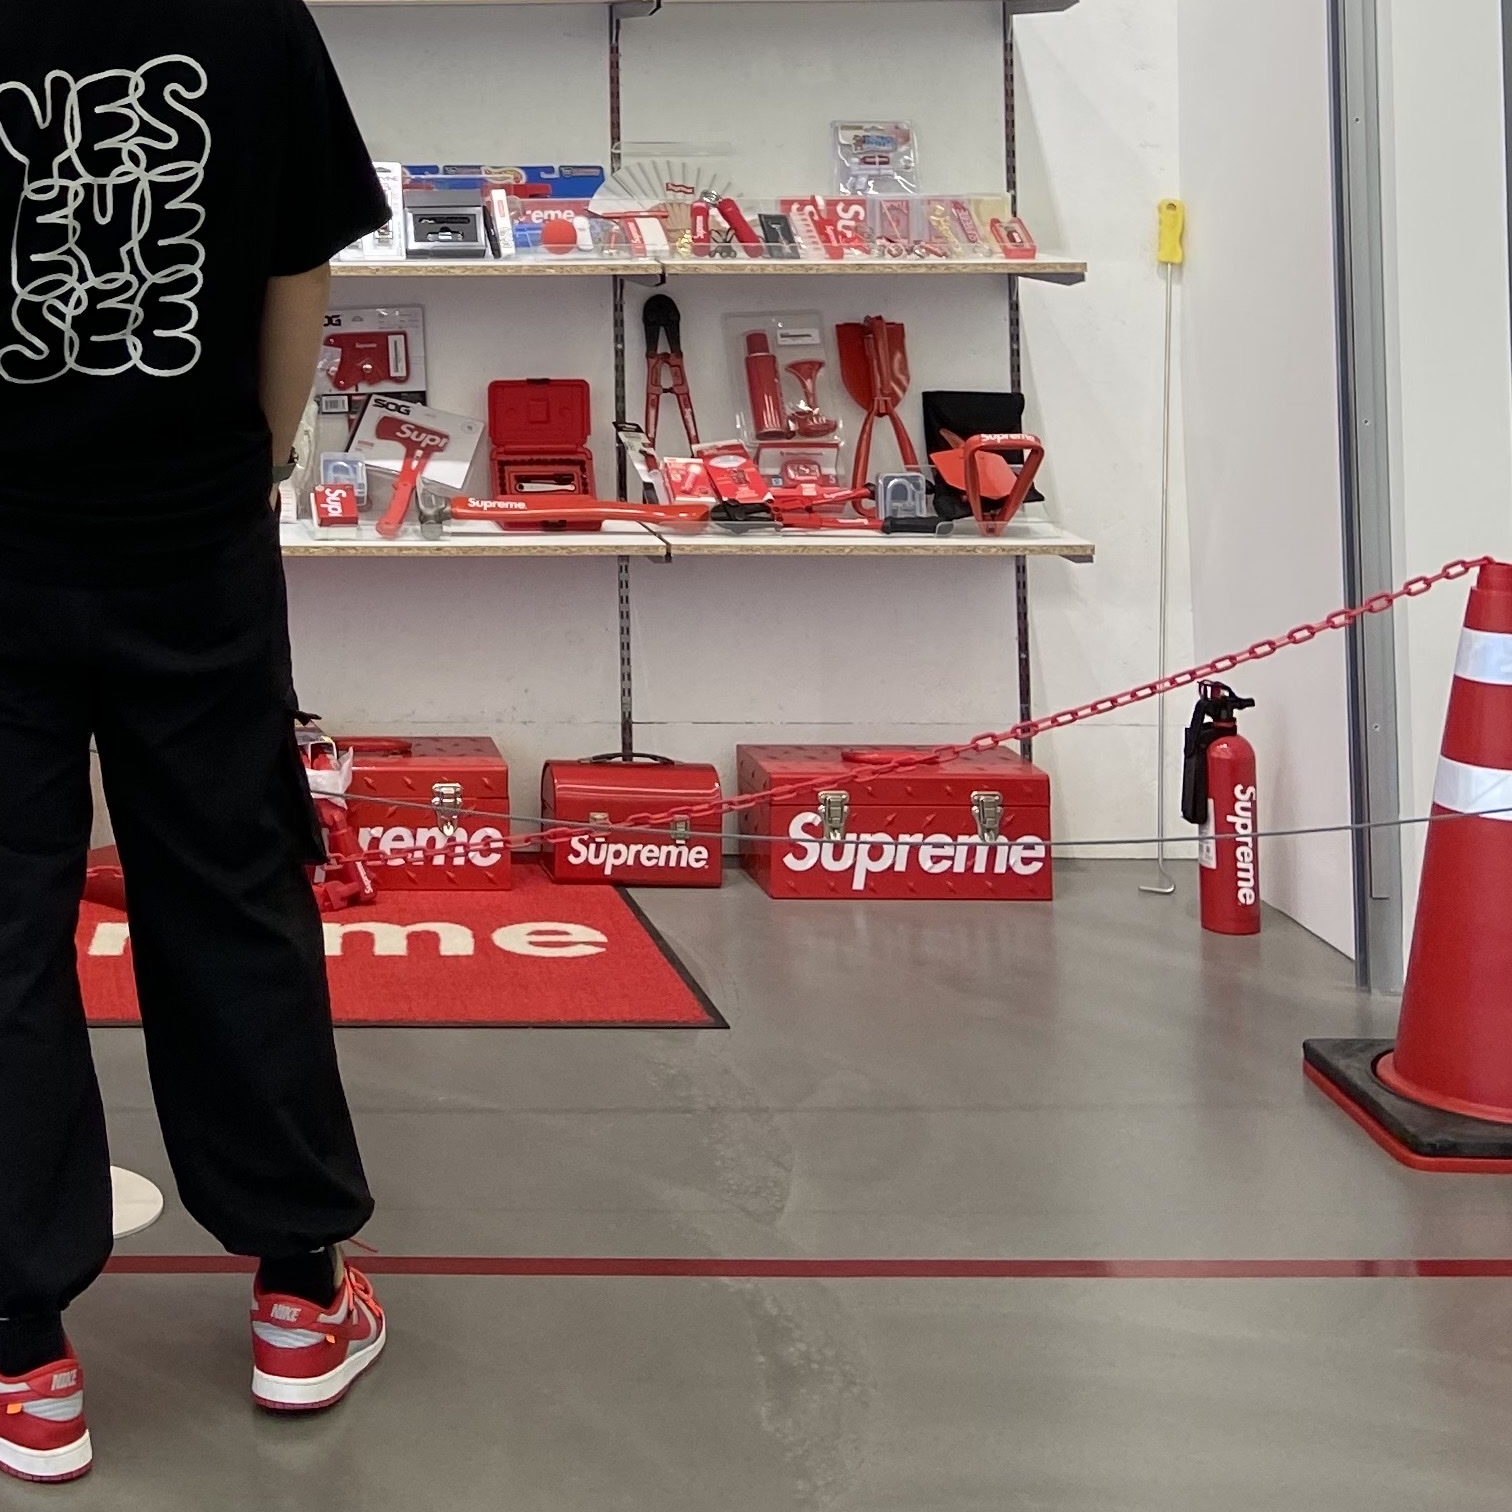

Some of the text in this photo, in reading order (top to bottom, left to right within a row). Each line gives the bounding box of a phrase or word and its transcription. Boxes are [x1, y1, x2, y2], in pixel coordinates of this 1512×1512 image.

[372, 397, 411, 416] SOG
[467, 497, 527, 510] Supreme
[568, 834, 709, 876] Supreme
[783, 811, 1046, 891] Supreme
[1226, 783, 1256, 906] Supreme
[271, 1303, 302, 1322] NIKE
[51, 1369, 77, 1391] NIKE
